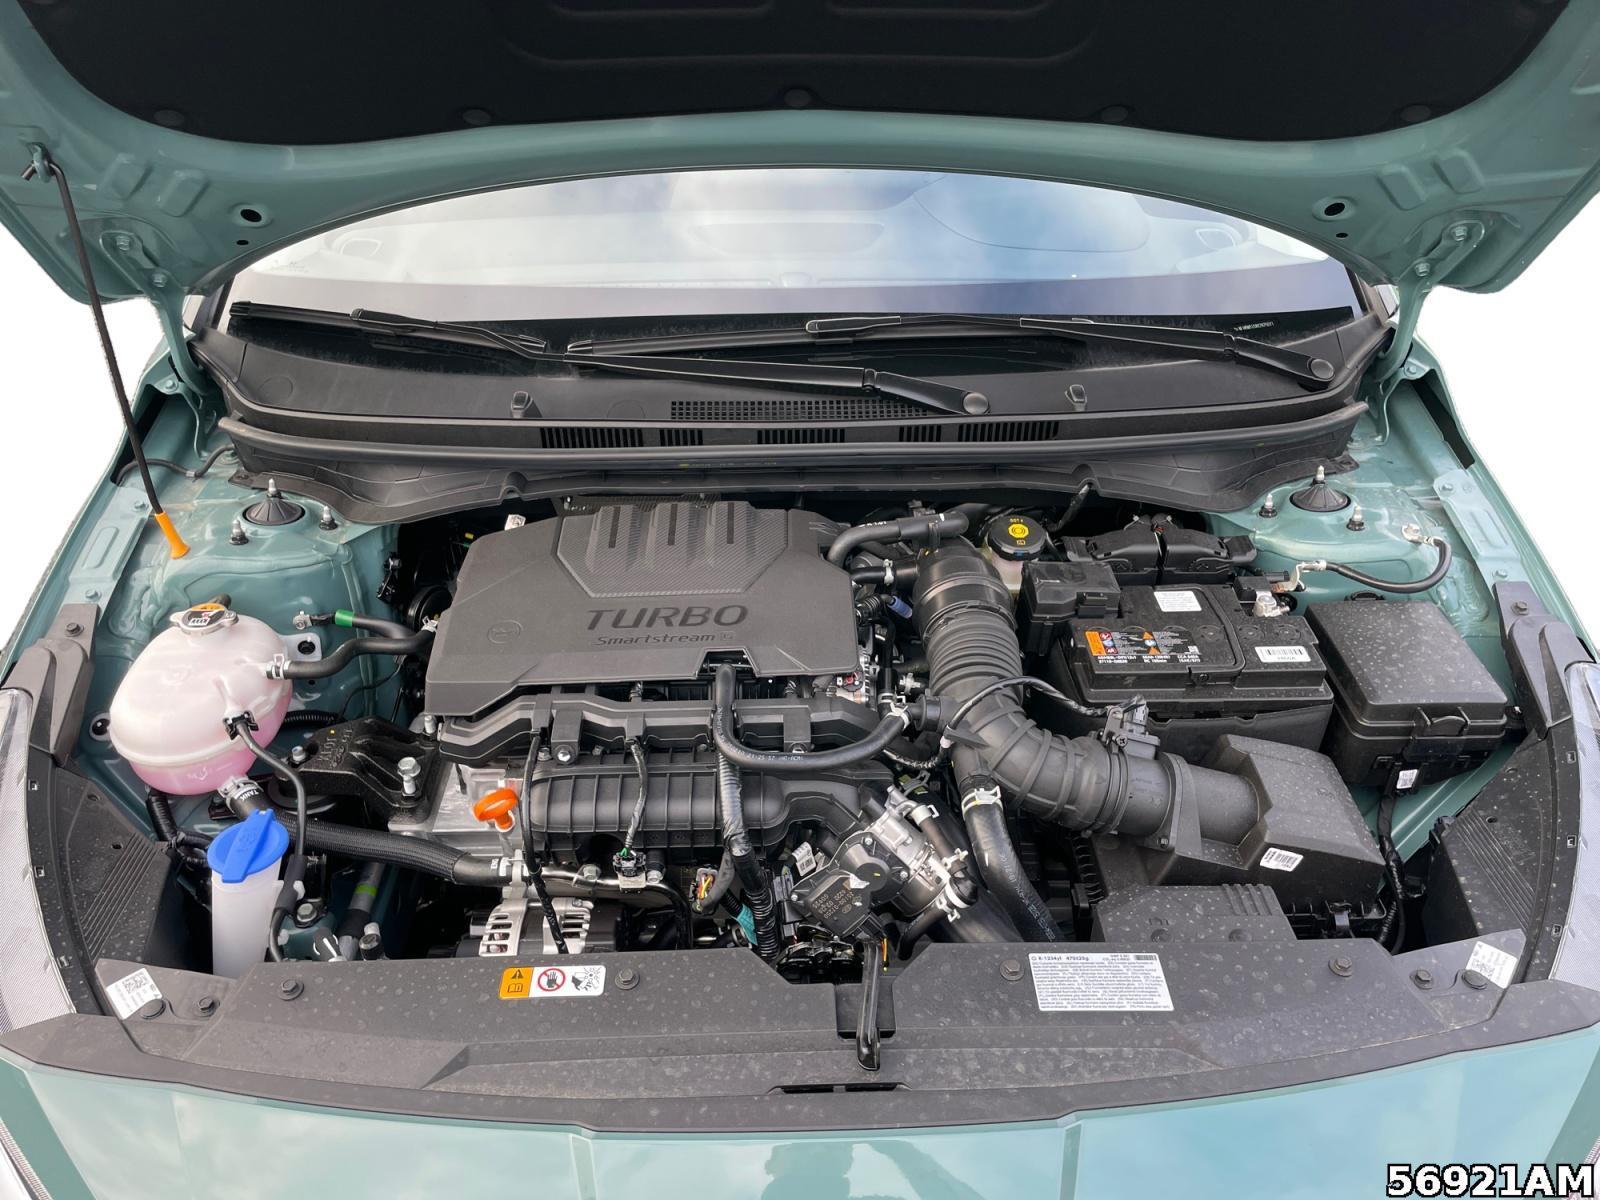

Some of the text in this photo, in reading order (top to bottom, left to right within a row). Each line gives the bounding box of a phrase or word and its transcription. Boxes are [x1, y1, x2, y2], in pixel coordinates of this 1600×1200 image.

[587, 604, 748, 631] TURBO
[593, 633, 716, 646] Smartstream
[240, 790, 259, 801] TANK
